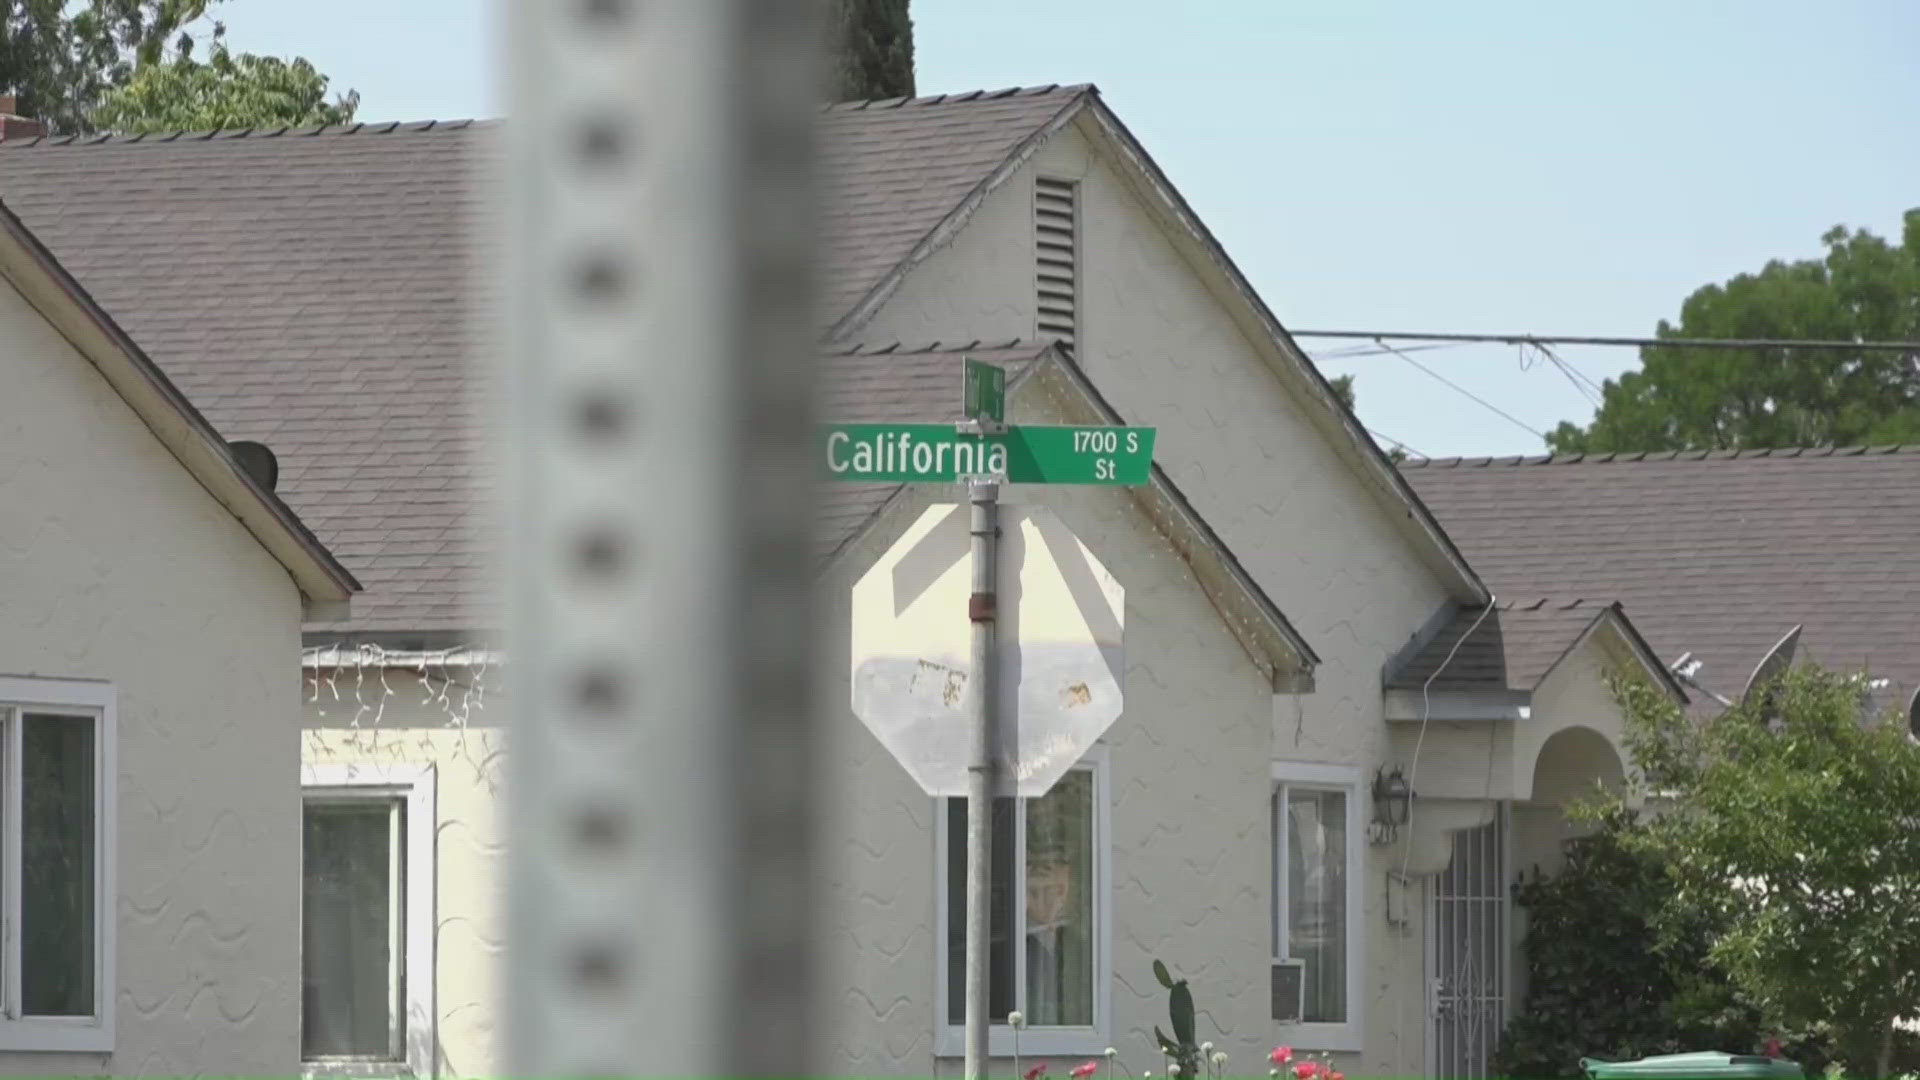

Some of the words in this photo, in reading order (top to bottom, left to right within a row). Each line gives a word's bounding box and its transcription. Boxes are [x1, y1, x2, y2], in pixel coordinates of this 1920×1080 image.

[827, 431, 1008, 474] California
[1073, 431, 1117, 453] 1700
[1126, 432, 1138, 453] S
[1095, 458, 1116, 480] St
